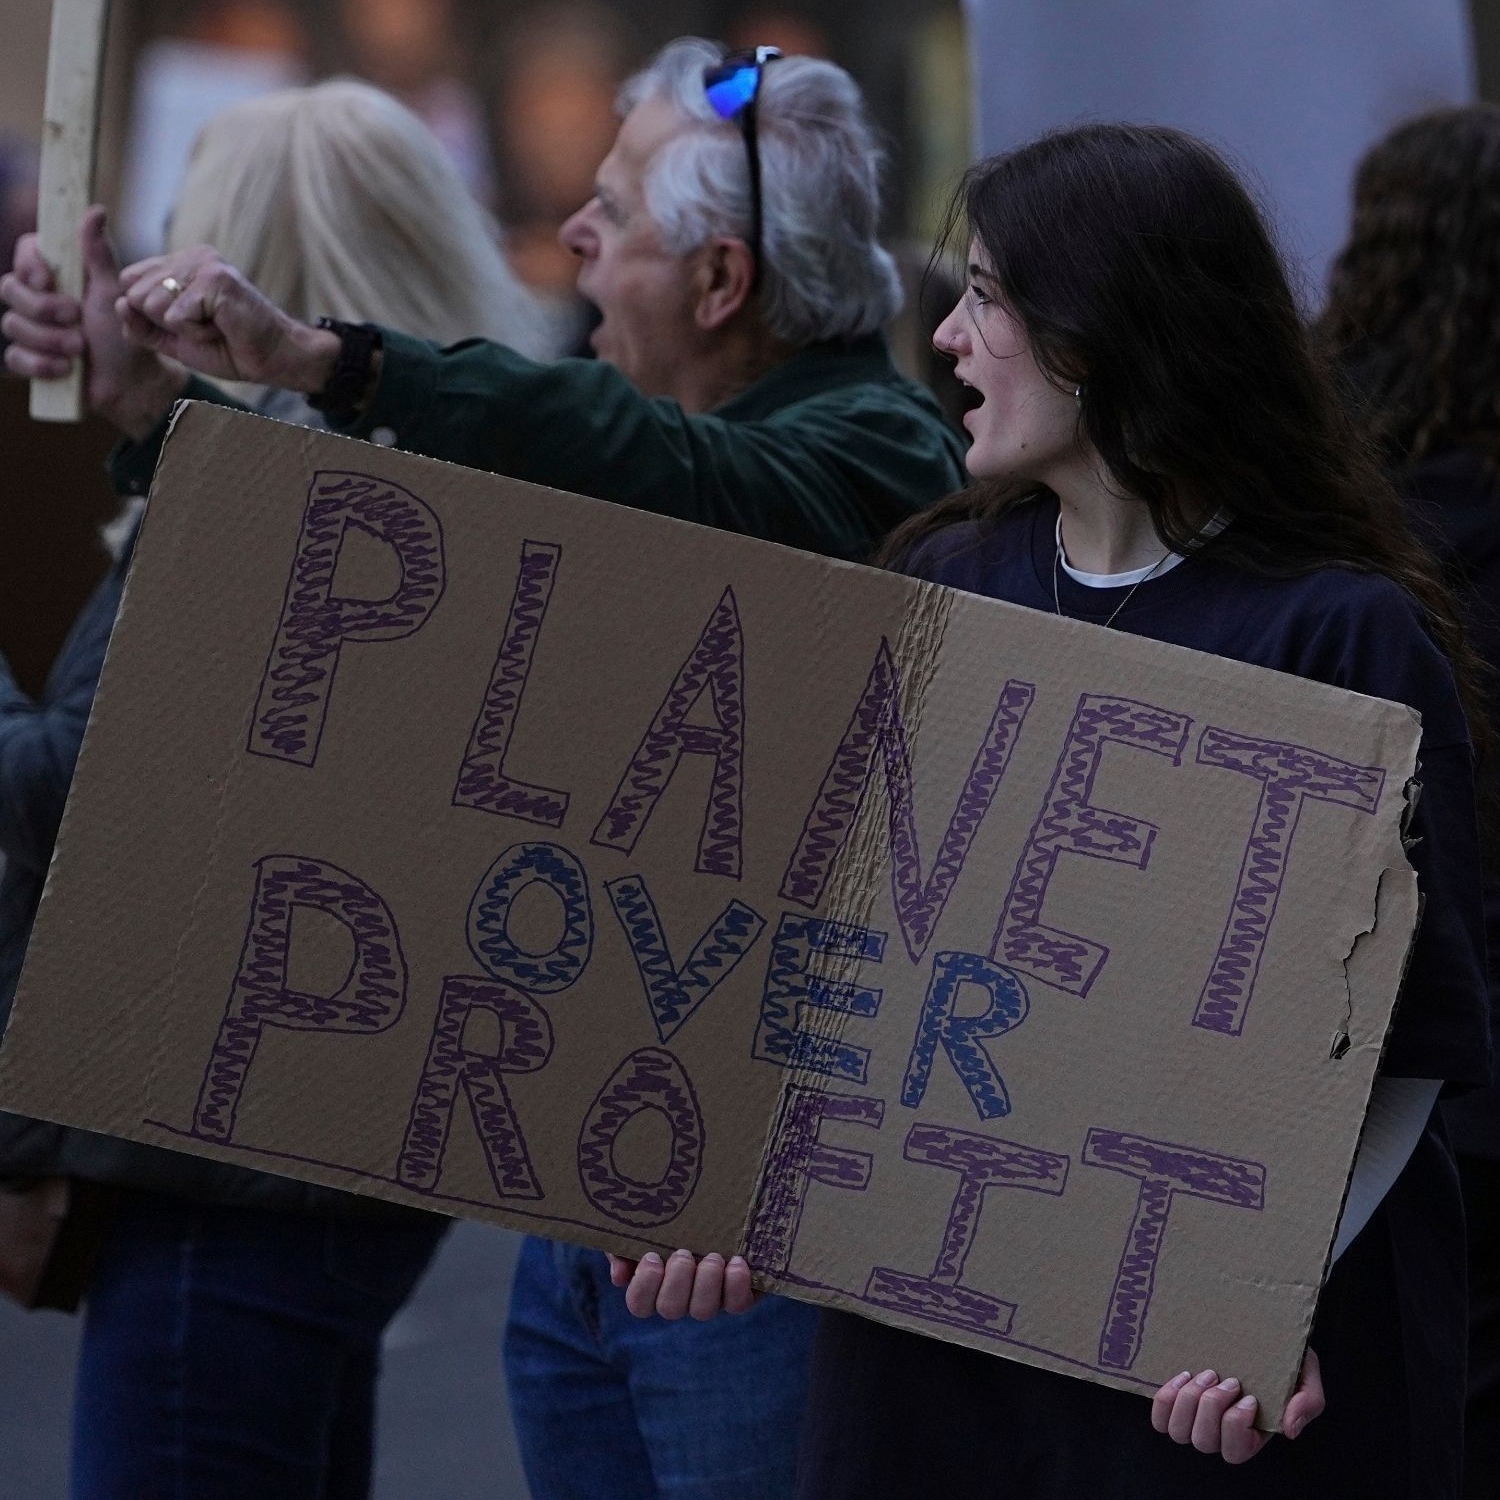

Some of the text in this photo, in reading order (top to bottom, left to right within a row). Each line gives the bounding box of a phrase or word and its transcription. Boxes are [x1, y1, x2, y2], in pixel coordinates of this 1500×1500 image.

[247, 471, 1386, 1037] PLANET
[465, 841, 1031, 1121] OVER
[193, 855, 1267, 1369] PROFIT
